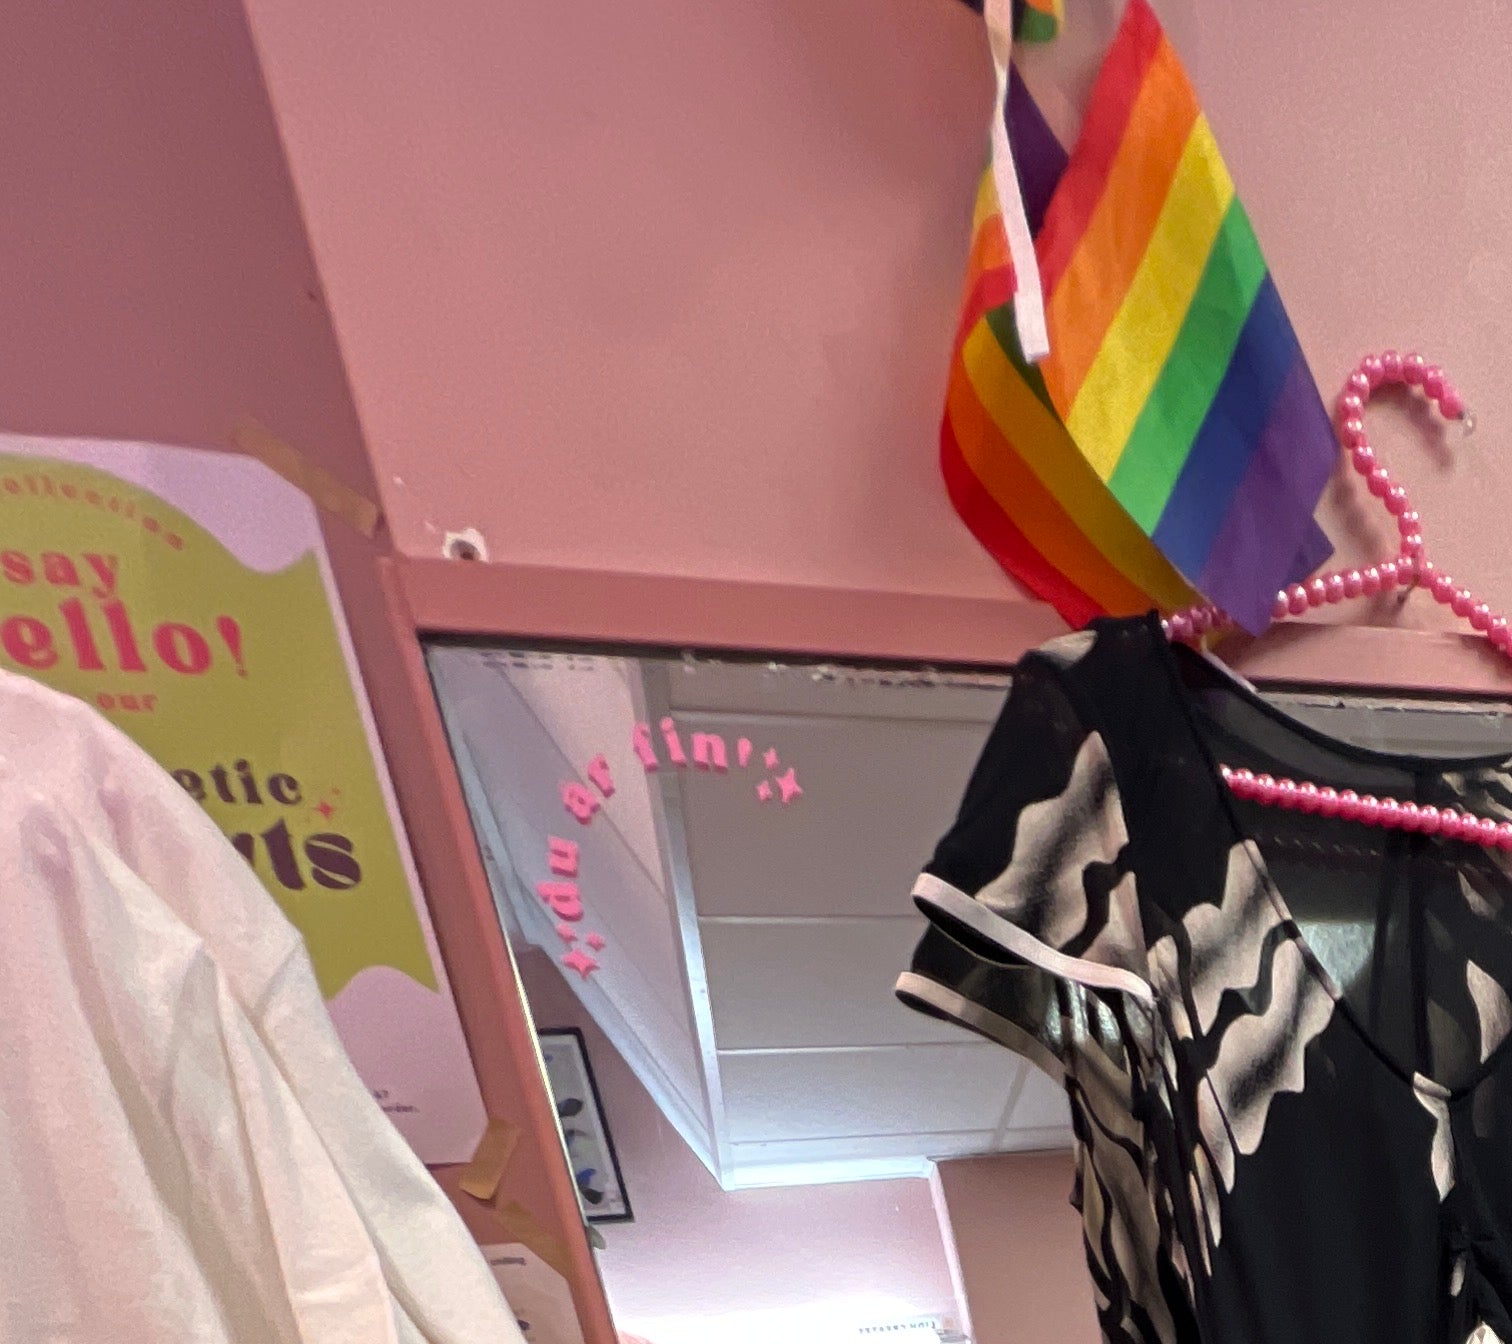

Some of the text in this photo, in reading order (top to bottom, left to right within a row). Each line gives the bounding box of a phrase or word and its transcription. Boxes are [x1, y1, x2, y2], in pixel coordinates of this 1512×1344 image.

[0, 474, 184, 551] ollection
[0, 550, 118, 600] say
[0, 596, 248, 679] ello!
[170, 758, 302, 806] etic
